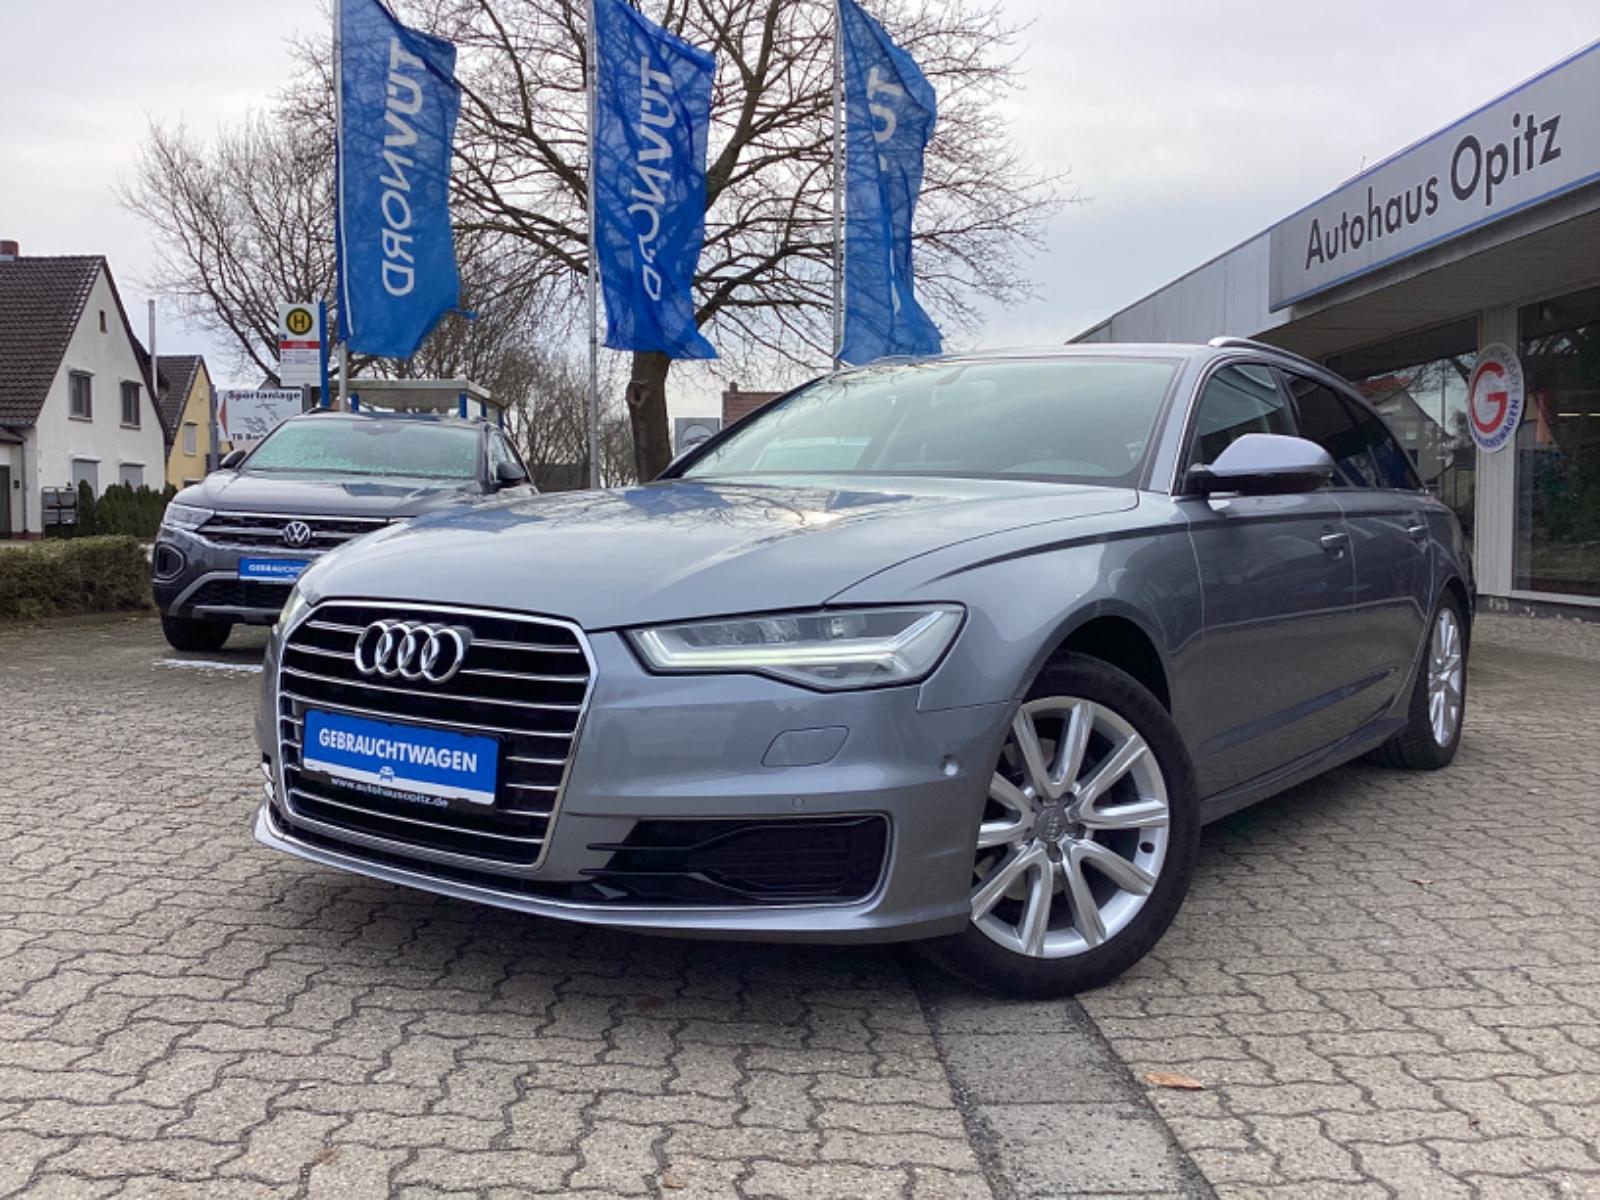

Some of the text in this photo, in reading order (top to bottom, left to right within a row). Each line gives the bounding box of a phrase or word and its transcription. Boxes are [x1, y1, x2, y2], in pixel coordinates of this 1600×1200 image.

[1305, 112, 1562, 271] Autohaus Opitz
[228, 390, 301, 402] Sportanlage
[1471, 361, 1509, 434] G
[319, 727, 478, 774] GEBRAUCHTWAGEN
[330, 776, 449, 808] www.autohausopitz.de
